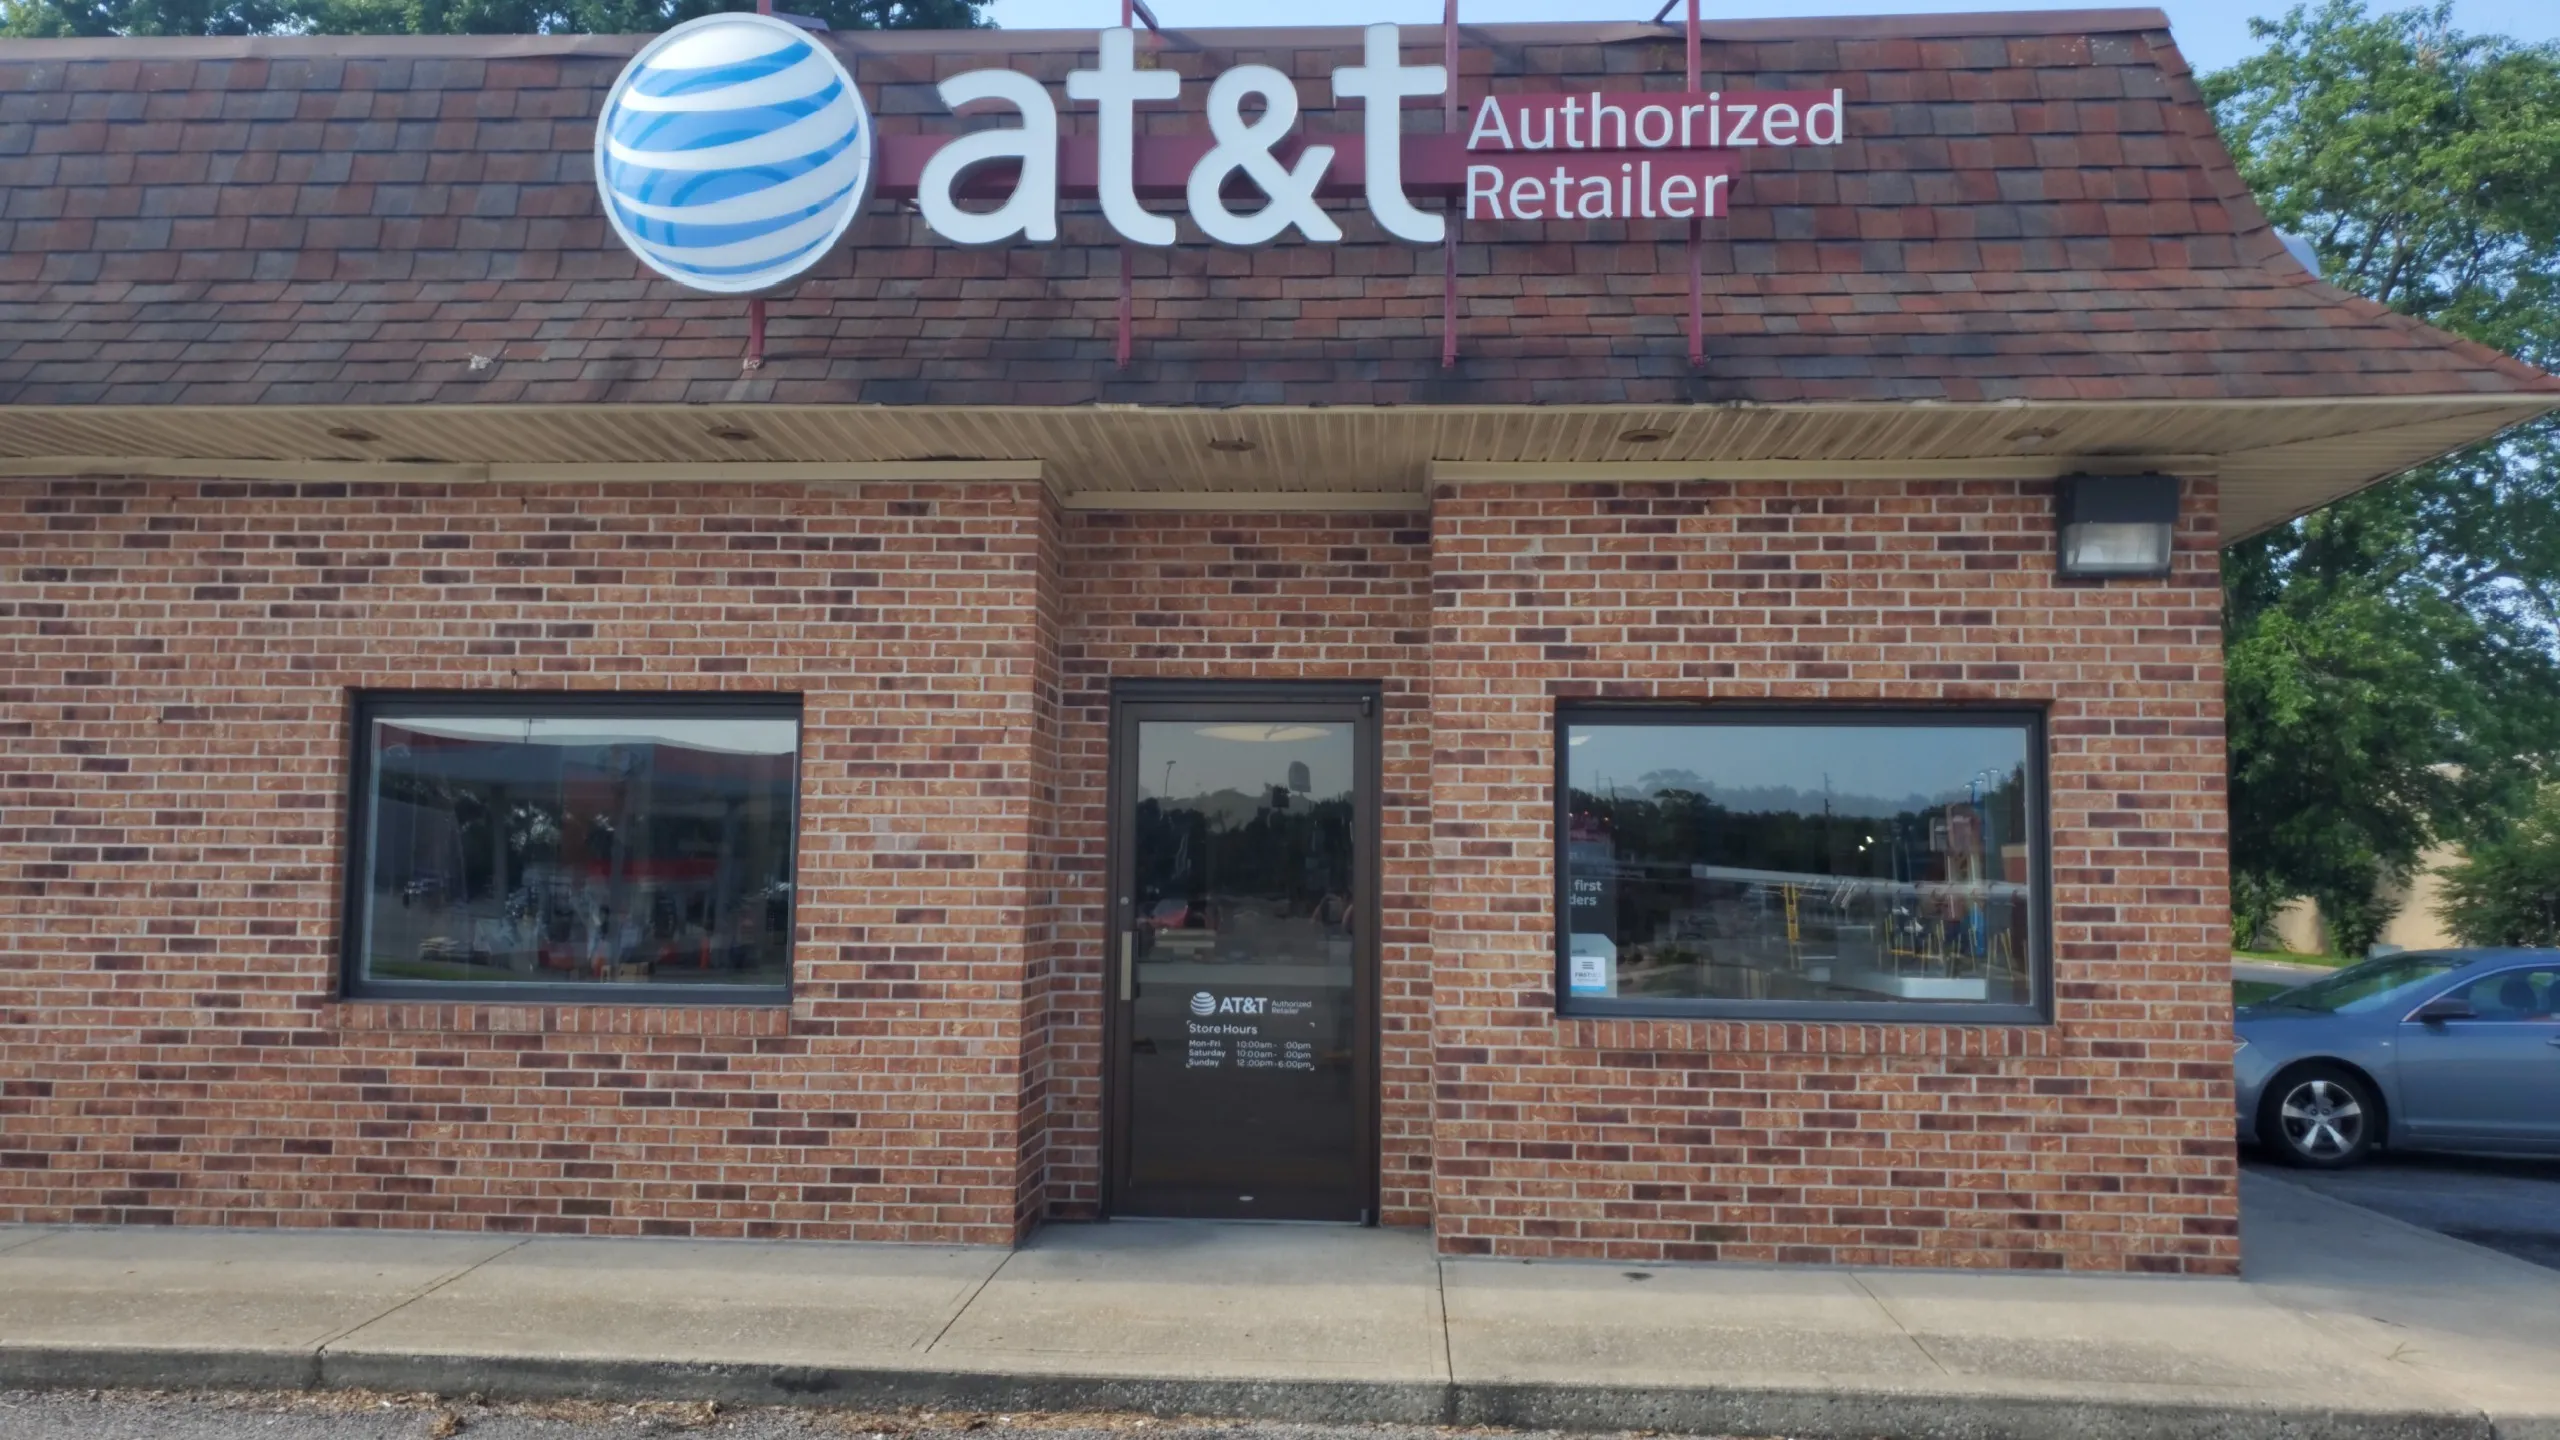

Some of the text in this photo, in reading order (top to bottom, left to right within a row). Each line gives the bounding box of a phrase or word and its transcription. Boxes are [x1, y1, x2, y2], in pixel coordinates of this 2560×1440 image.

[1466, 88, 1843, 150] Authorized
[918, 23, 1447, 245] at&t
[1466, 160, 1729, 220] Retailer
[1574, 879, 1603, 892] first
[1219, 997, 1268, 1014] AT&T
[1272, 1000, 1312, 1008] Authorized
[1189, 1023, 1258, 1035] Store Hours
[1189, 1040, 1221, 1048] Mon-Fri
[1189, 1049, 1226, 1058] Saturday
[1189, 1058, 1220, 1068] Sunday
